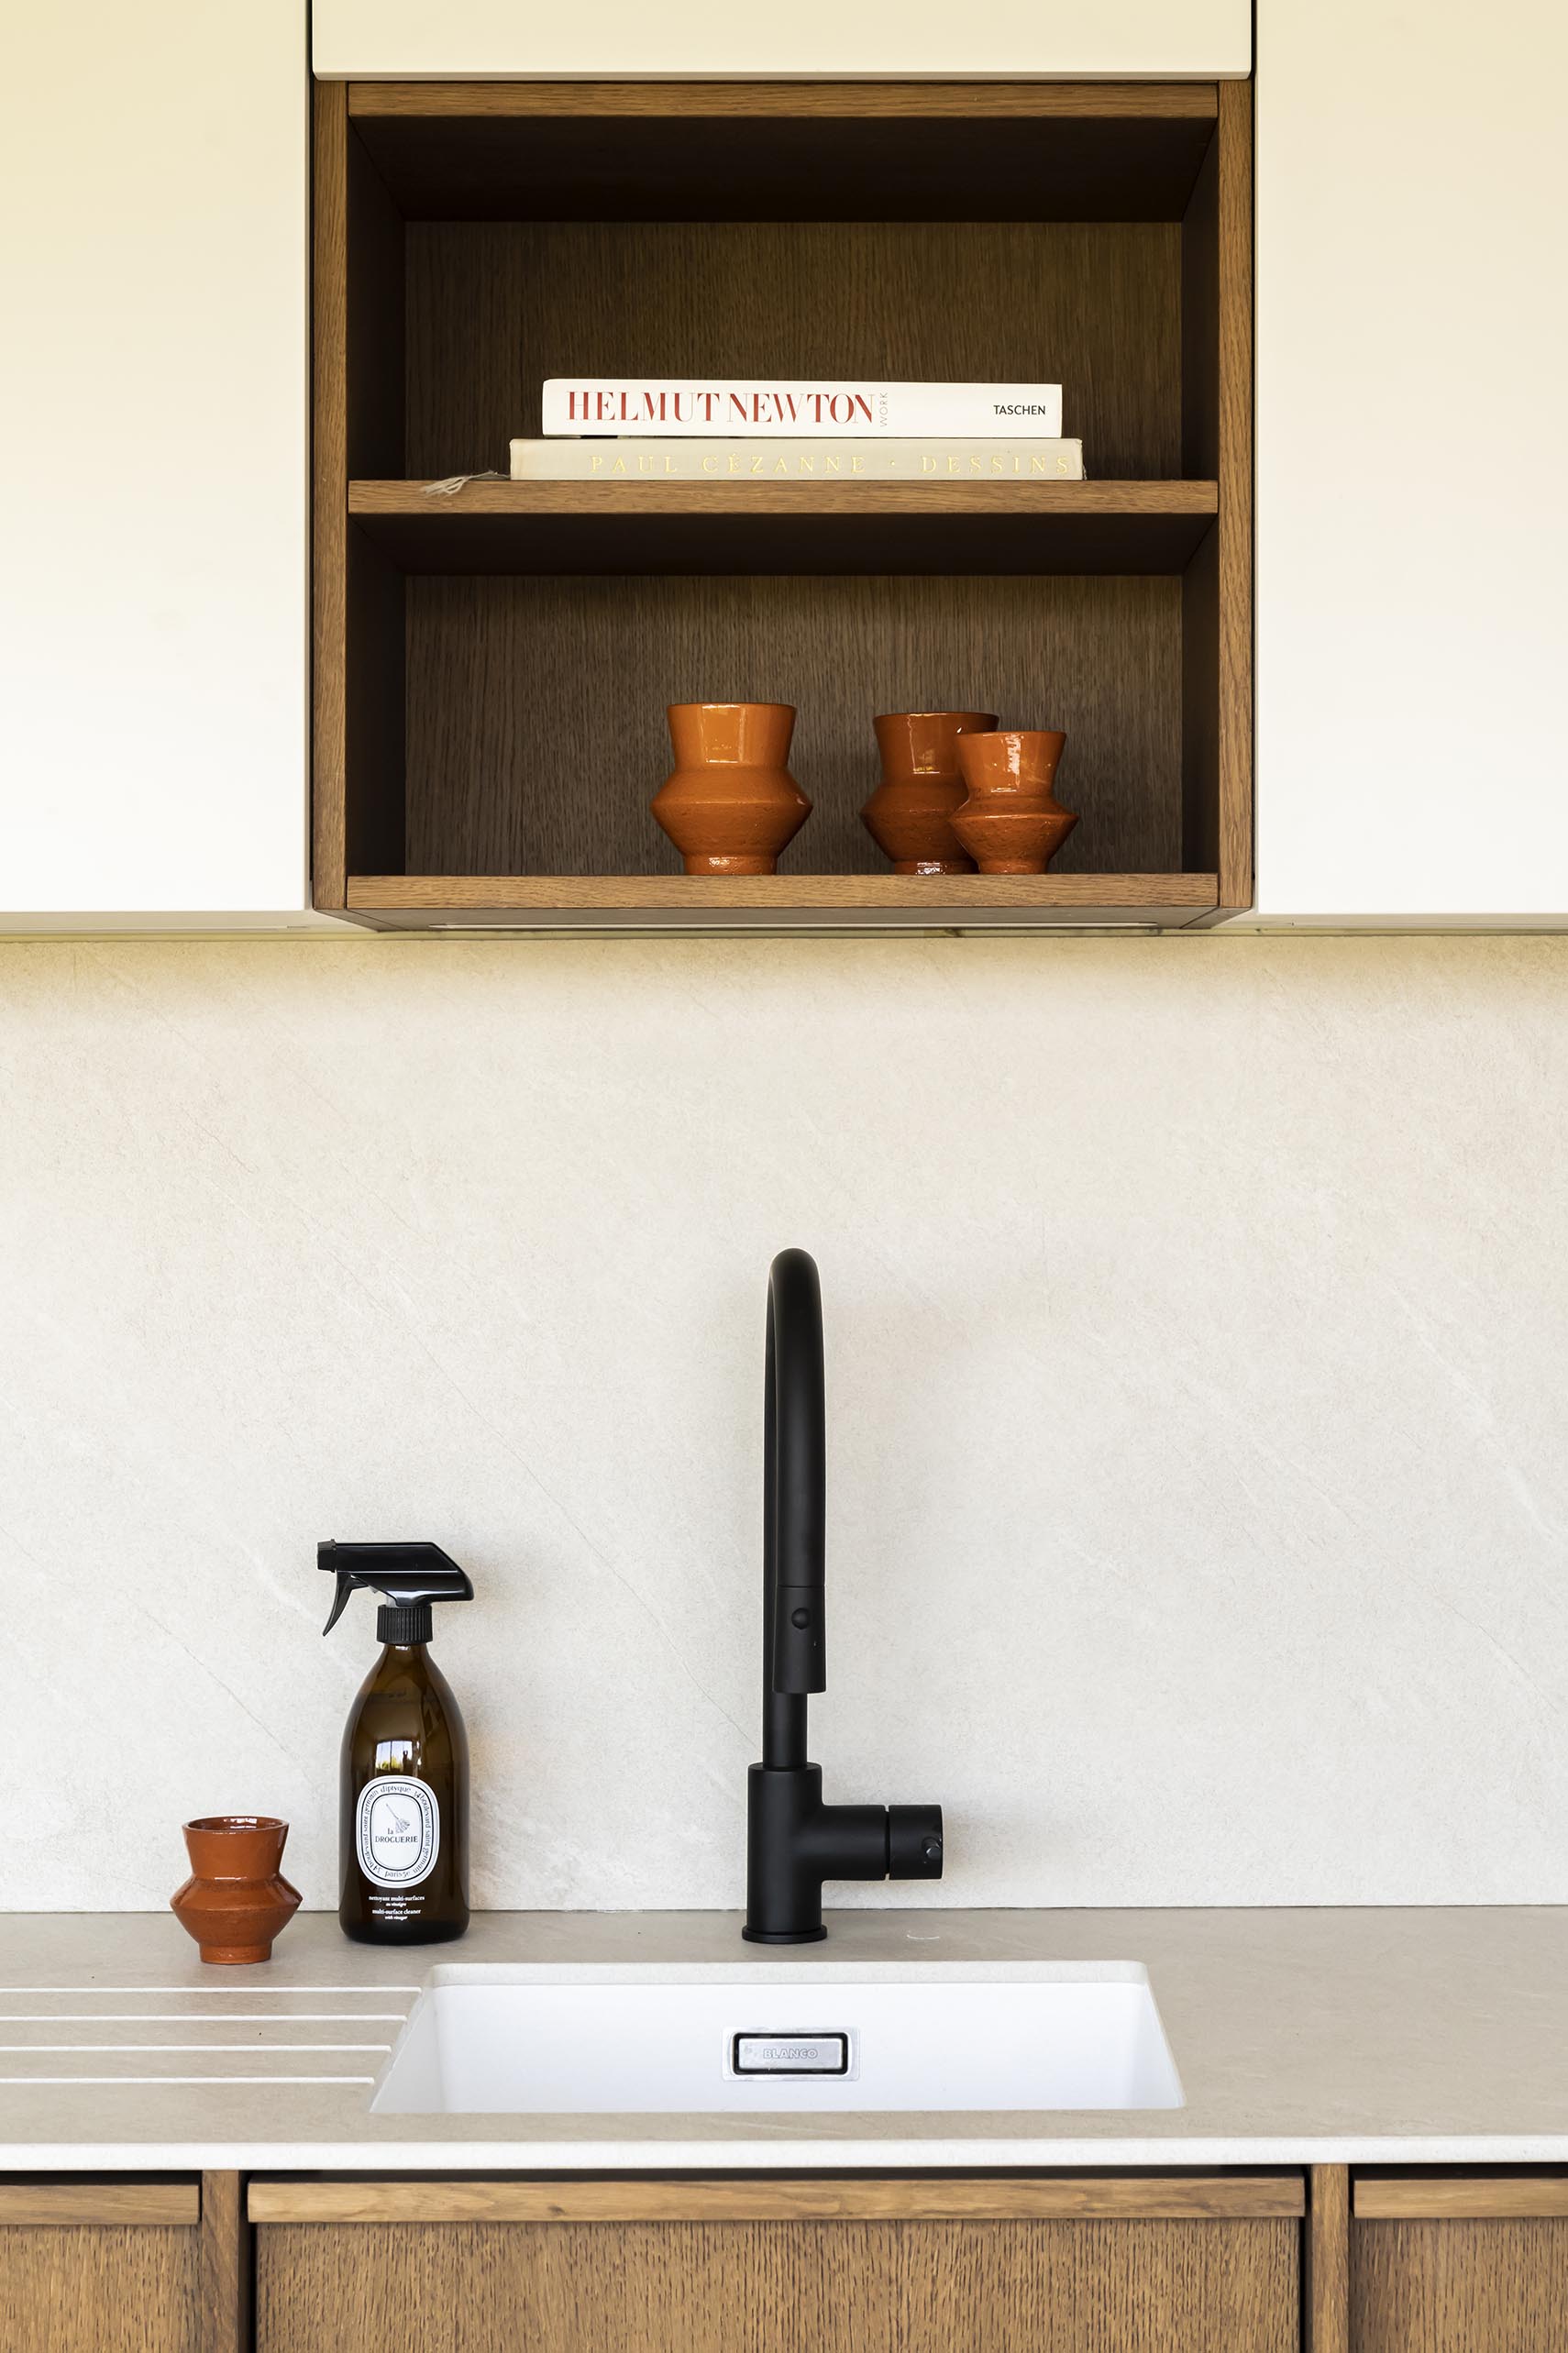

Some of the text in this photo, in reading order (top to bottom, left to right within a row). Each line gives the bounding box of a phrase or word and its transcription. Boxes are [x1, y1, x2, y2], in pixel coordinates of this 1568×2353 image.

[566, 391, 876, 425] HELMUT NEWTON
[879, 392, 889, 427] WORK
[993, 404, 1046, 415] TASCHEN
[590, 452, 1071, 475] PAUL CÉZANNE DESSINS
[763, 2048, 819, 2060] BLANCO
